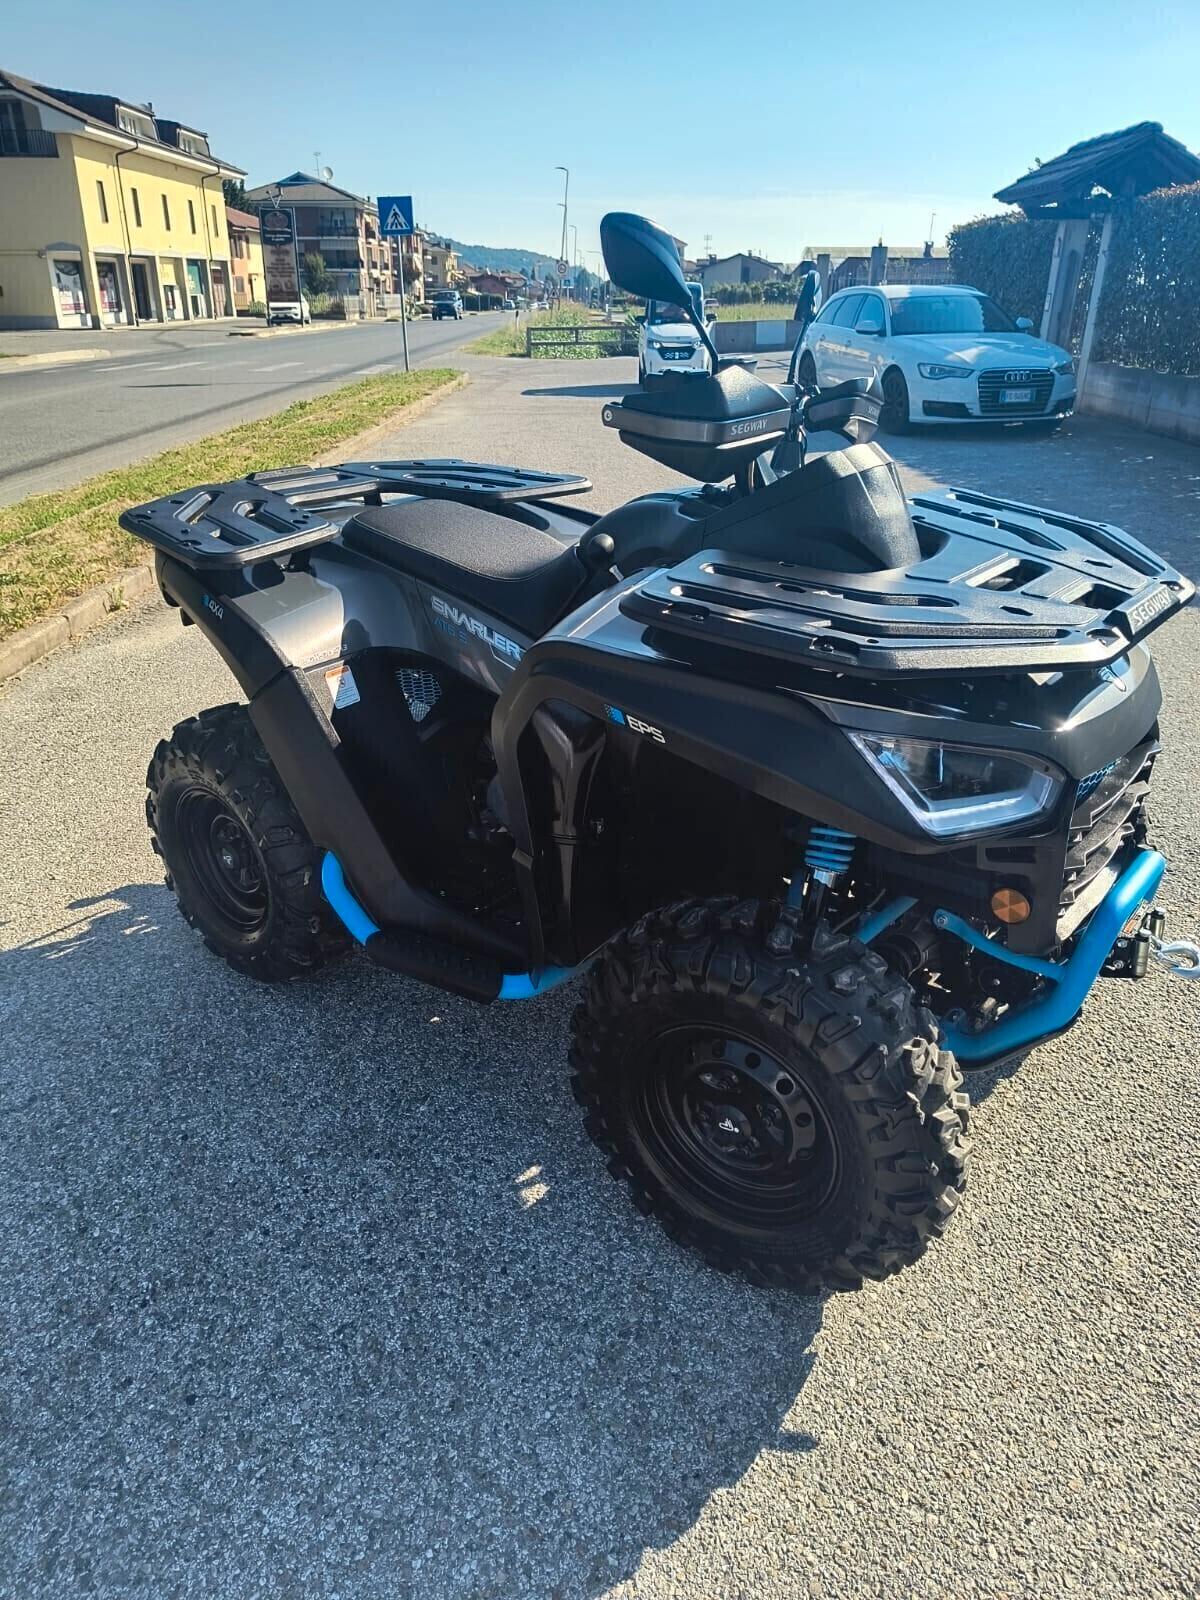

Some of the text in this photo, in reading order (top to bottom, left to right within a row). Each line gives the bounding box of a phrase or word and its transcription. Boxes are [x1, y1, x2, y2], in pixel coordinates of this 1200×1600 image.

[730, 418, 768, 436] SEGWAY
[1132, 588, 1171, 626] SEGWAY
[431, 595, 521, 661] SNARLER
[626, 714, 666, 743] EPS
